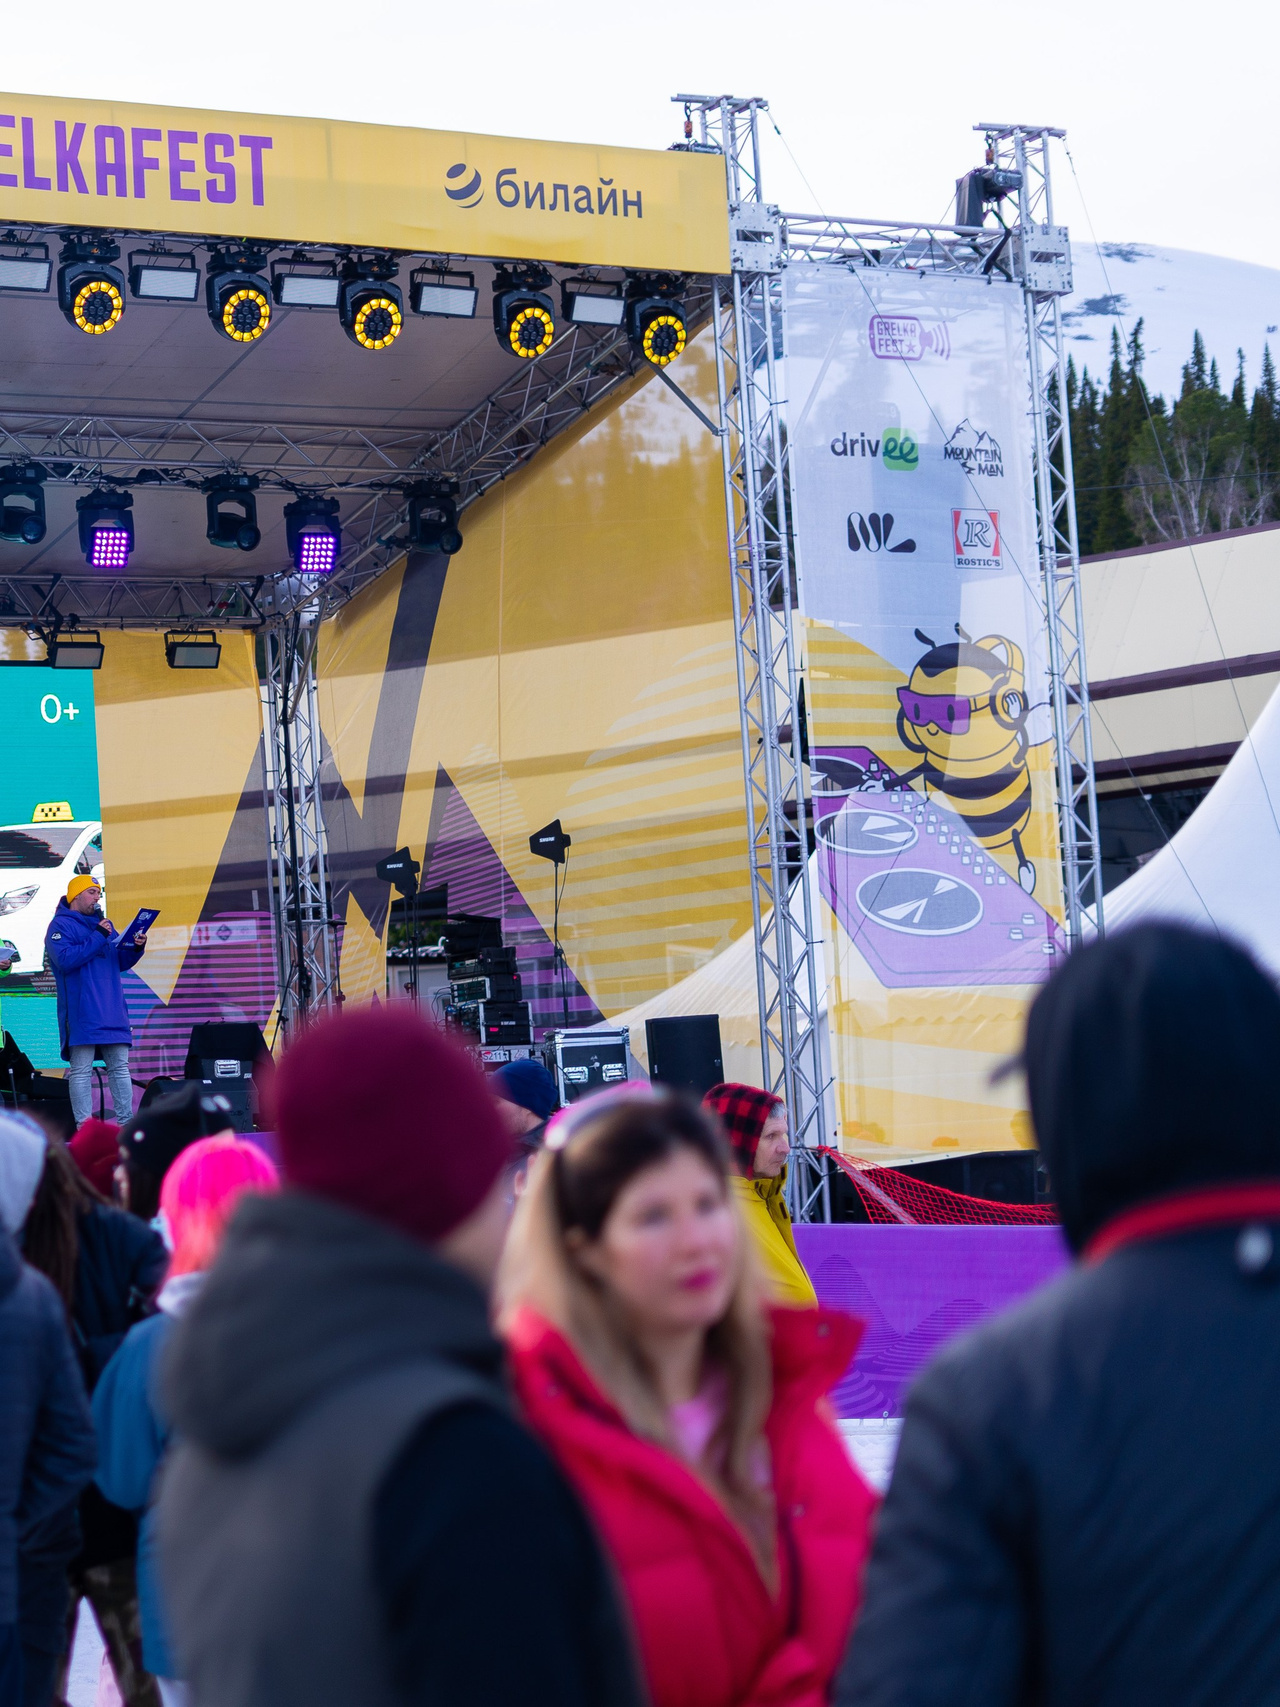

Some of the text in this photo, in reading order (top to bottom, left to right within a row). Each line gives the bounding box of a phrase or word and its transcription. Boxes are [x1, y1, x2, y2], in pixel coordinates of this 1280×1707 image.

[495, 167, 643, 219] билайн
[876, 321, 917, 338] GRELKA
[878, 338, 905, 353] FEST
[830, 431, 919, 464] drivee
[944, 446, 1002, 463] MOUNTAIN
[978, 462, 1004, 477] MAN
[957, 557, 1001, 567] ROSTIC'S
[40, 694, 79, 724] 0+
